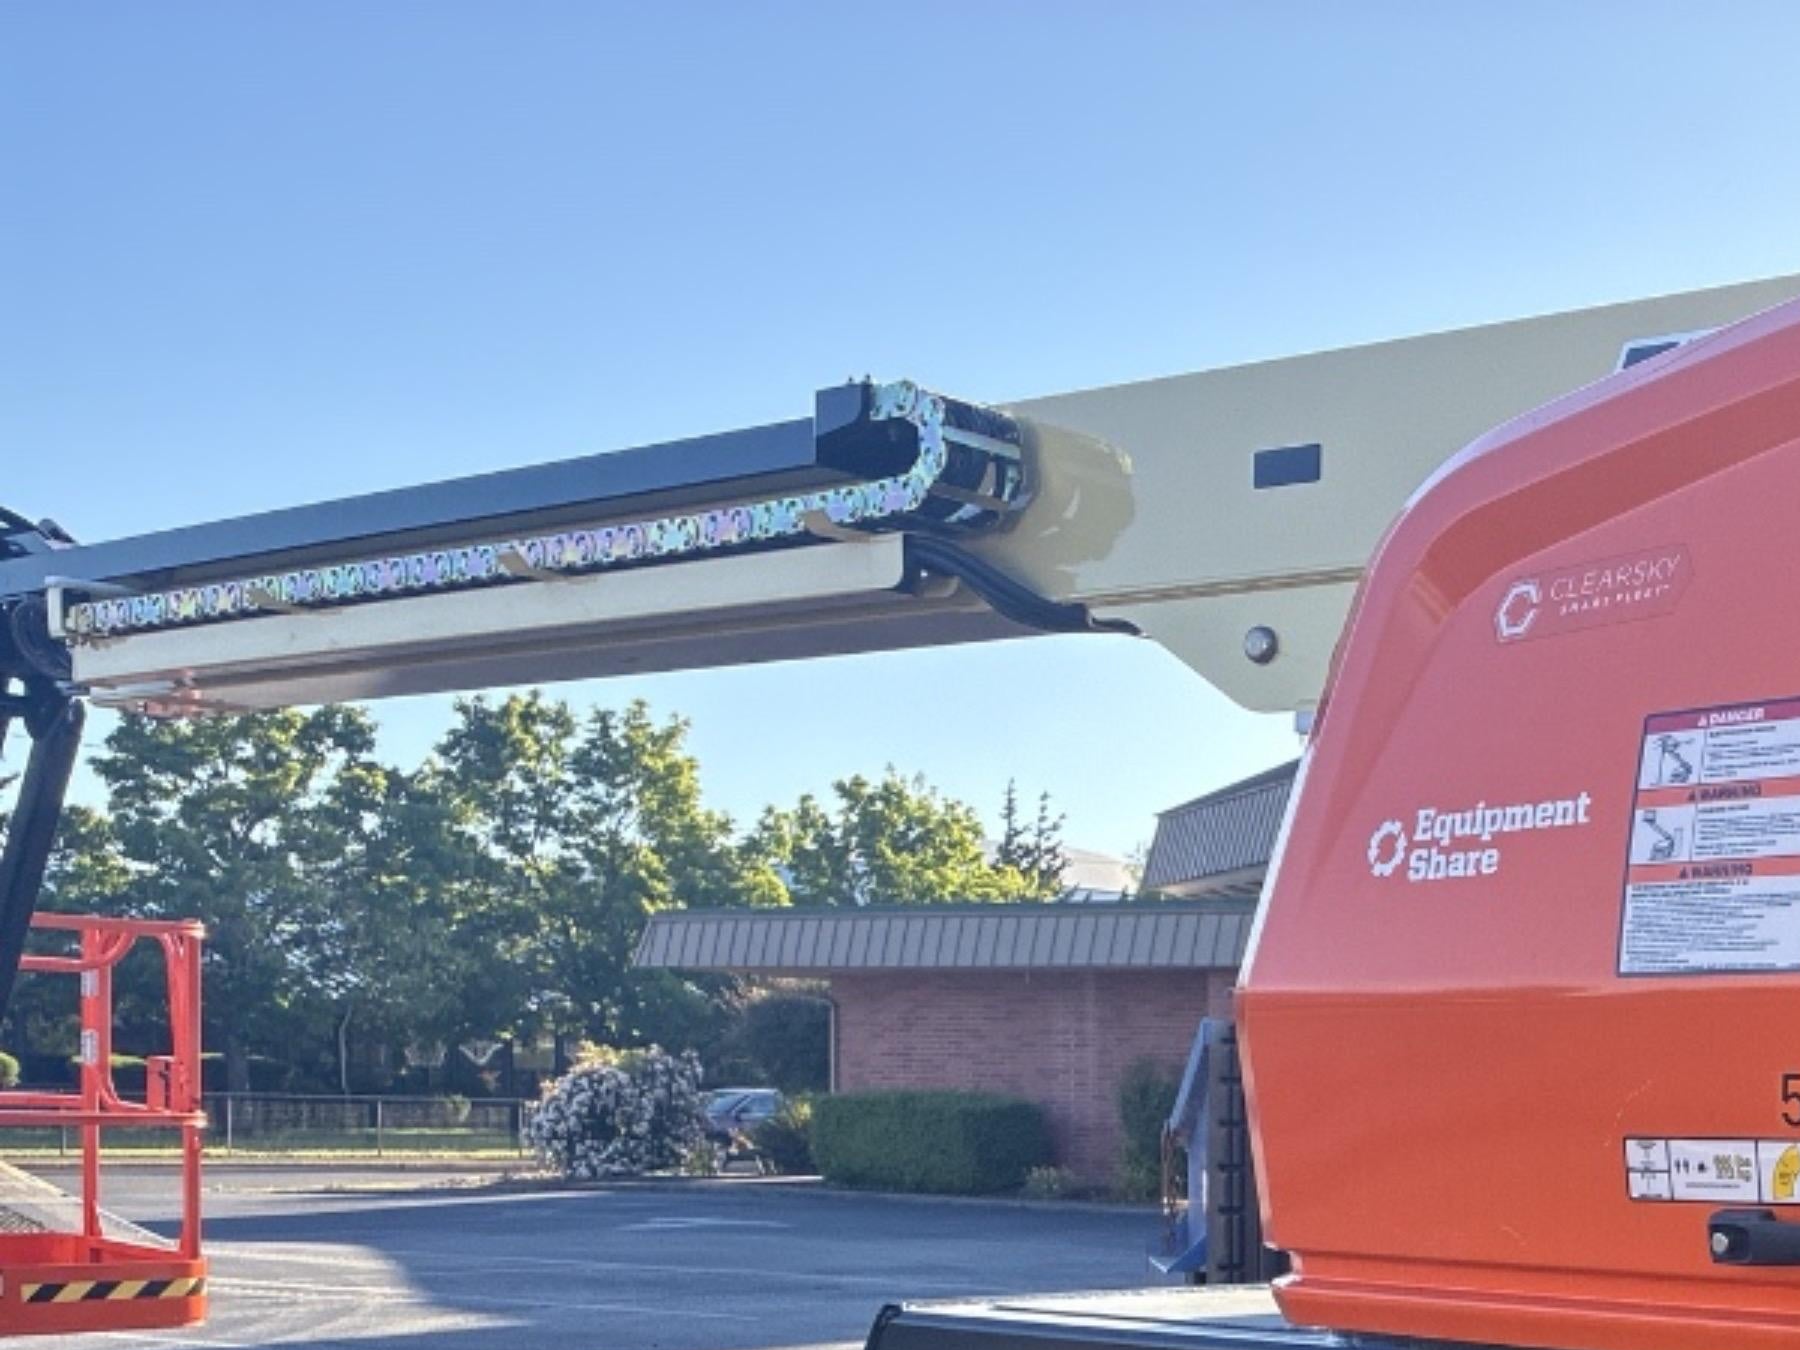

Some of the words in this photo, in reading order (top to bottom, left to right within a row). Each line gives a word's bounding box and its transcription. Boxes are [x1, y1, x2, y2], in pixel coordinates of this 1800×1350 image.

[1551, 554, 1680, 600] CLEARSKY
[1413, 791, 1592, 846] Equipment
[1407, 848, 1499, 883] Share
